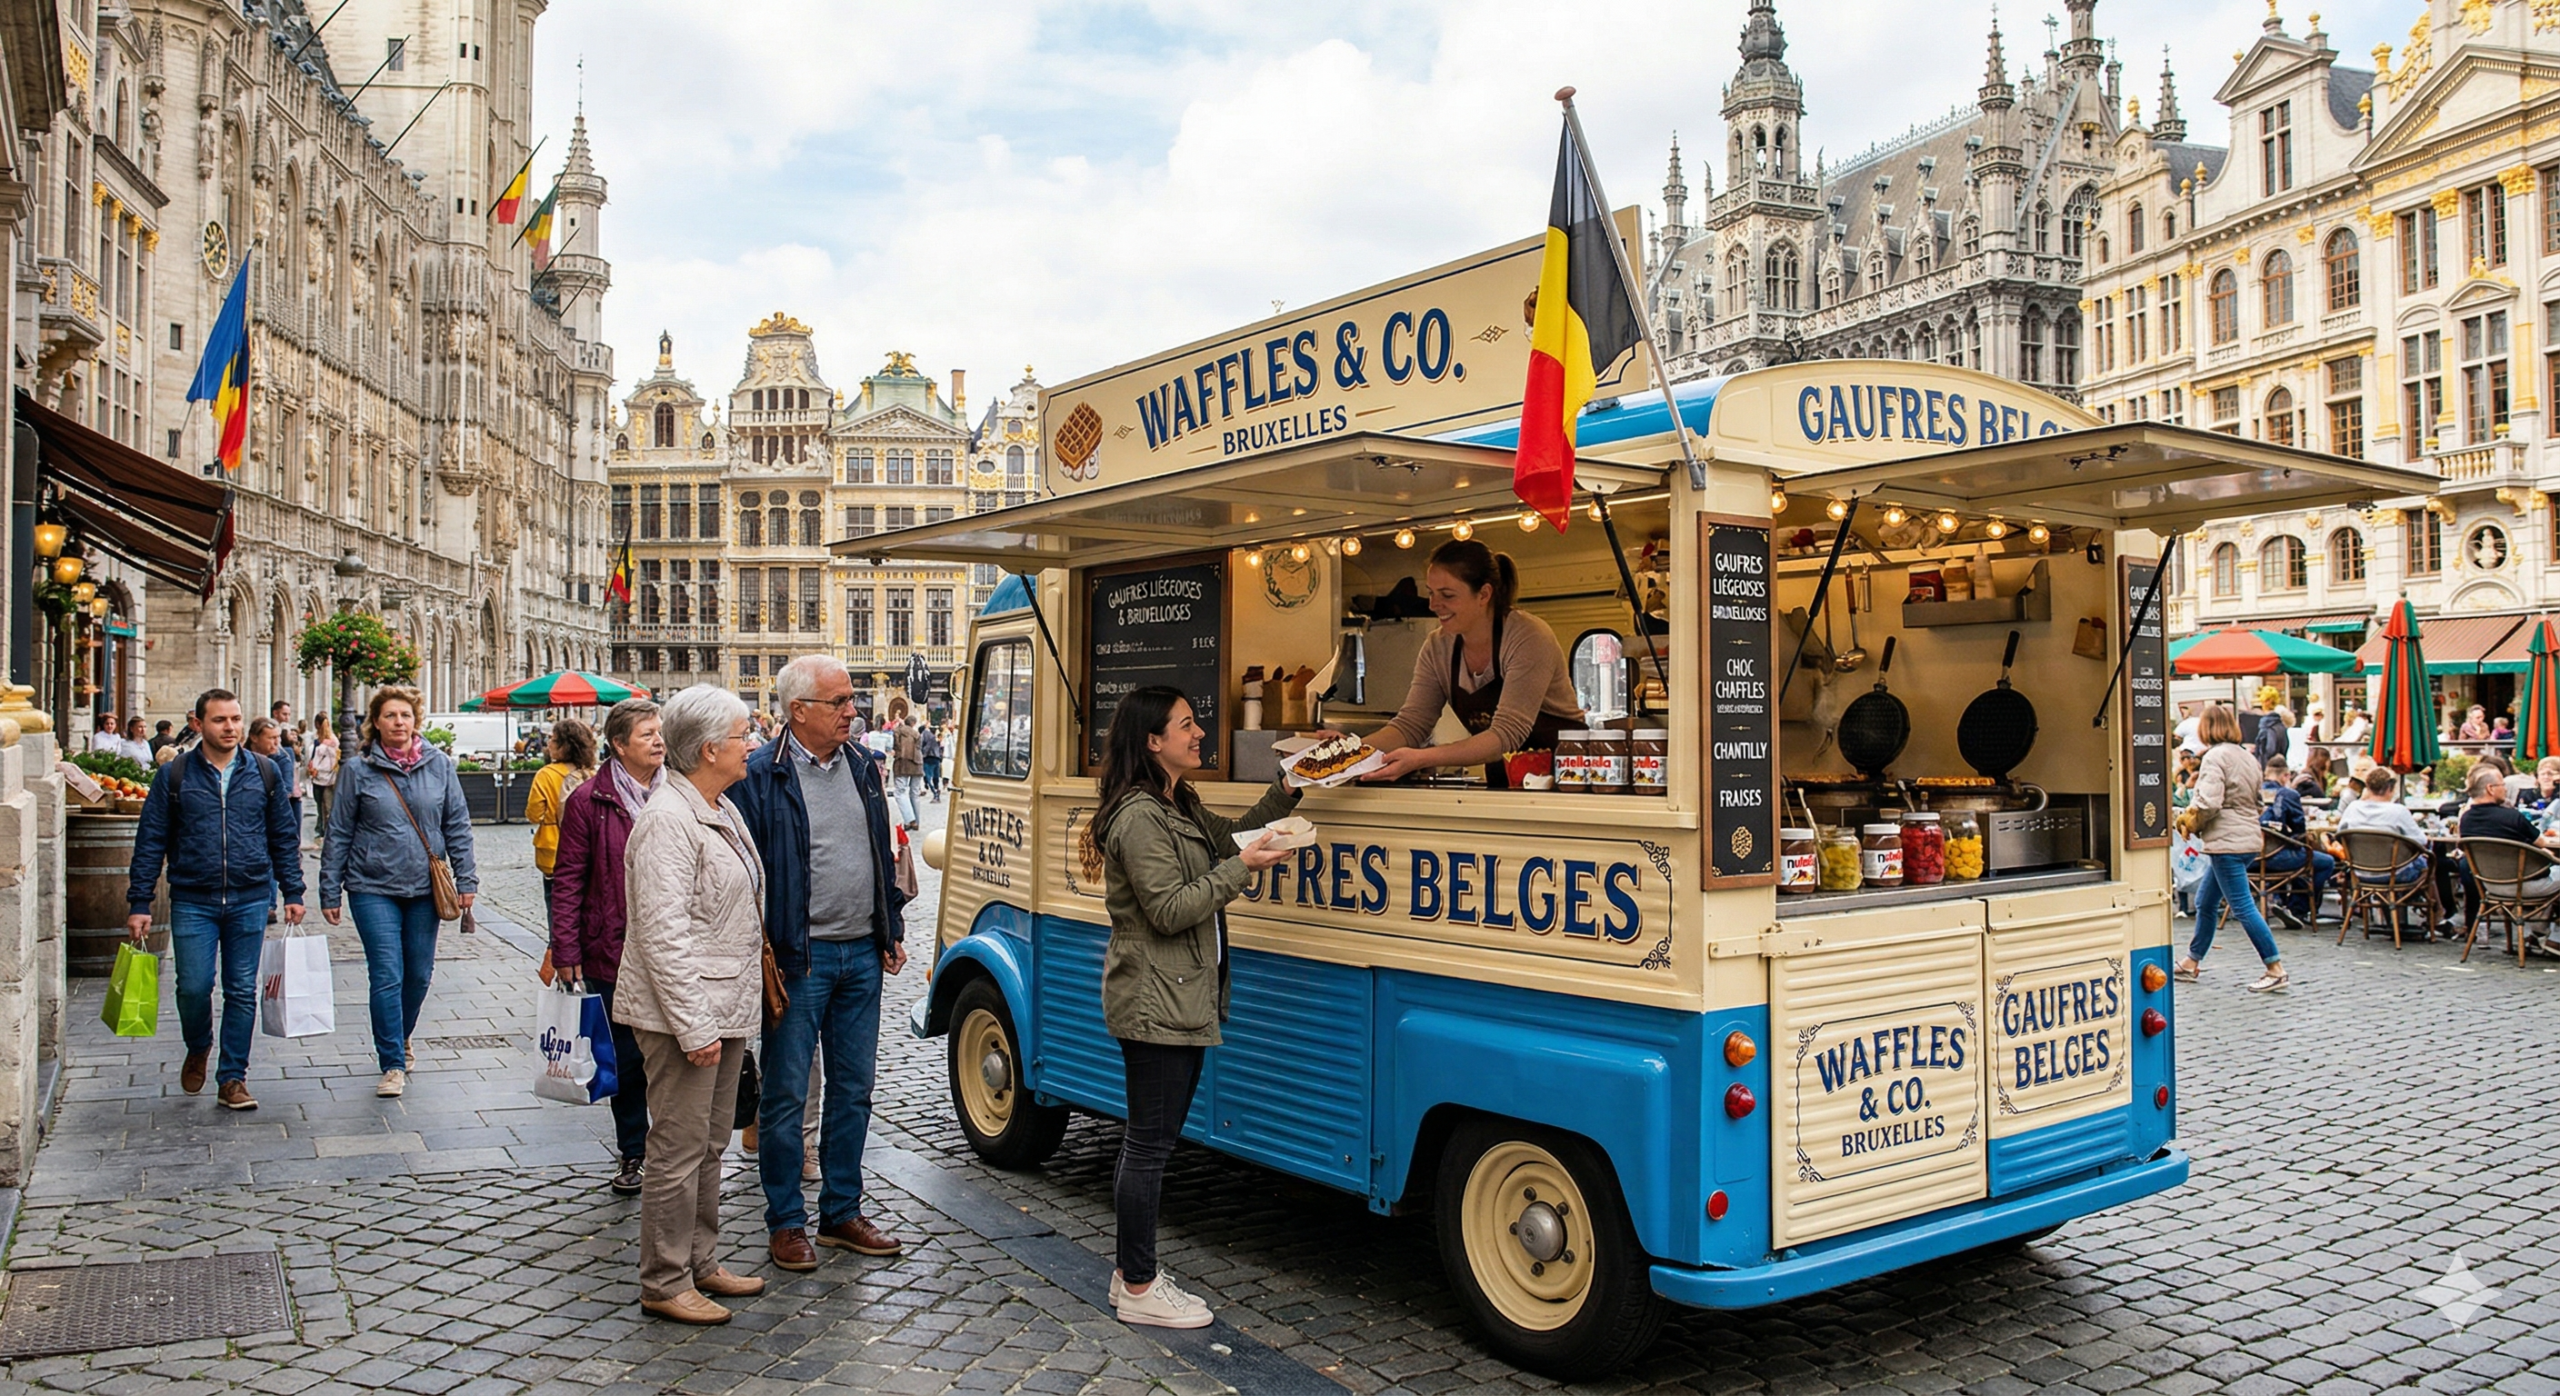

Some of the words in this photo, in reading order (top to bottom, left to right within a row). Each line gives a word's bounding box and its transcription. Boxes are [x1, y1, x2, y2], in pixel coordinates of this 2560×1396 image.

[1136, 329, 1319, 452] WAFFLES
[1333, 320, 1369, 391] &
[1382, 307, 1467, 386] CO.
[1223, 404, 1348, 456] BRUXELLES
[1799, 384, 1969, 448] GAUFRES
[1713, 552, 1763, 574] GAUFRES
[1108, 581, 1148, 609] GAUFRES
[1715, 680, 1765, 699] CHAFFLES
[1726, 658, 1755, 677] CHOC
[1713, 741, 1768, 760] CHANTILLY
[1720, 789, 1762, 808] FRAISES
[962, 806, 1024, 850] WAFFLES
[979, 841, 986, 862] &
[1409, 848, 1643, 945] BELGES
[2002, 974, 2119, 1038] GAUFRES
[1814, 1024, 1968, 1095] WAFFLES
[2014, 1028, 2112, 1091] BELGES
[1858, 1086, 1879, 1123] &
[1887, 1075, 1932, 1117] CO.
[1841, 1113, 1946, 1158] BRUXELLES
